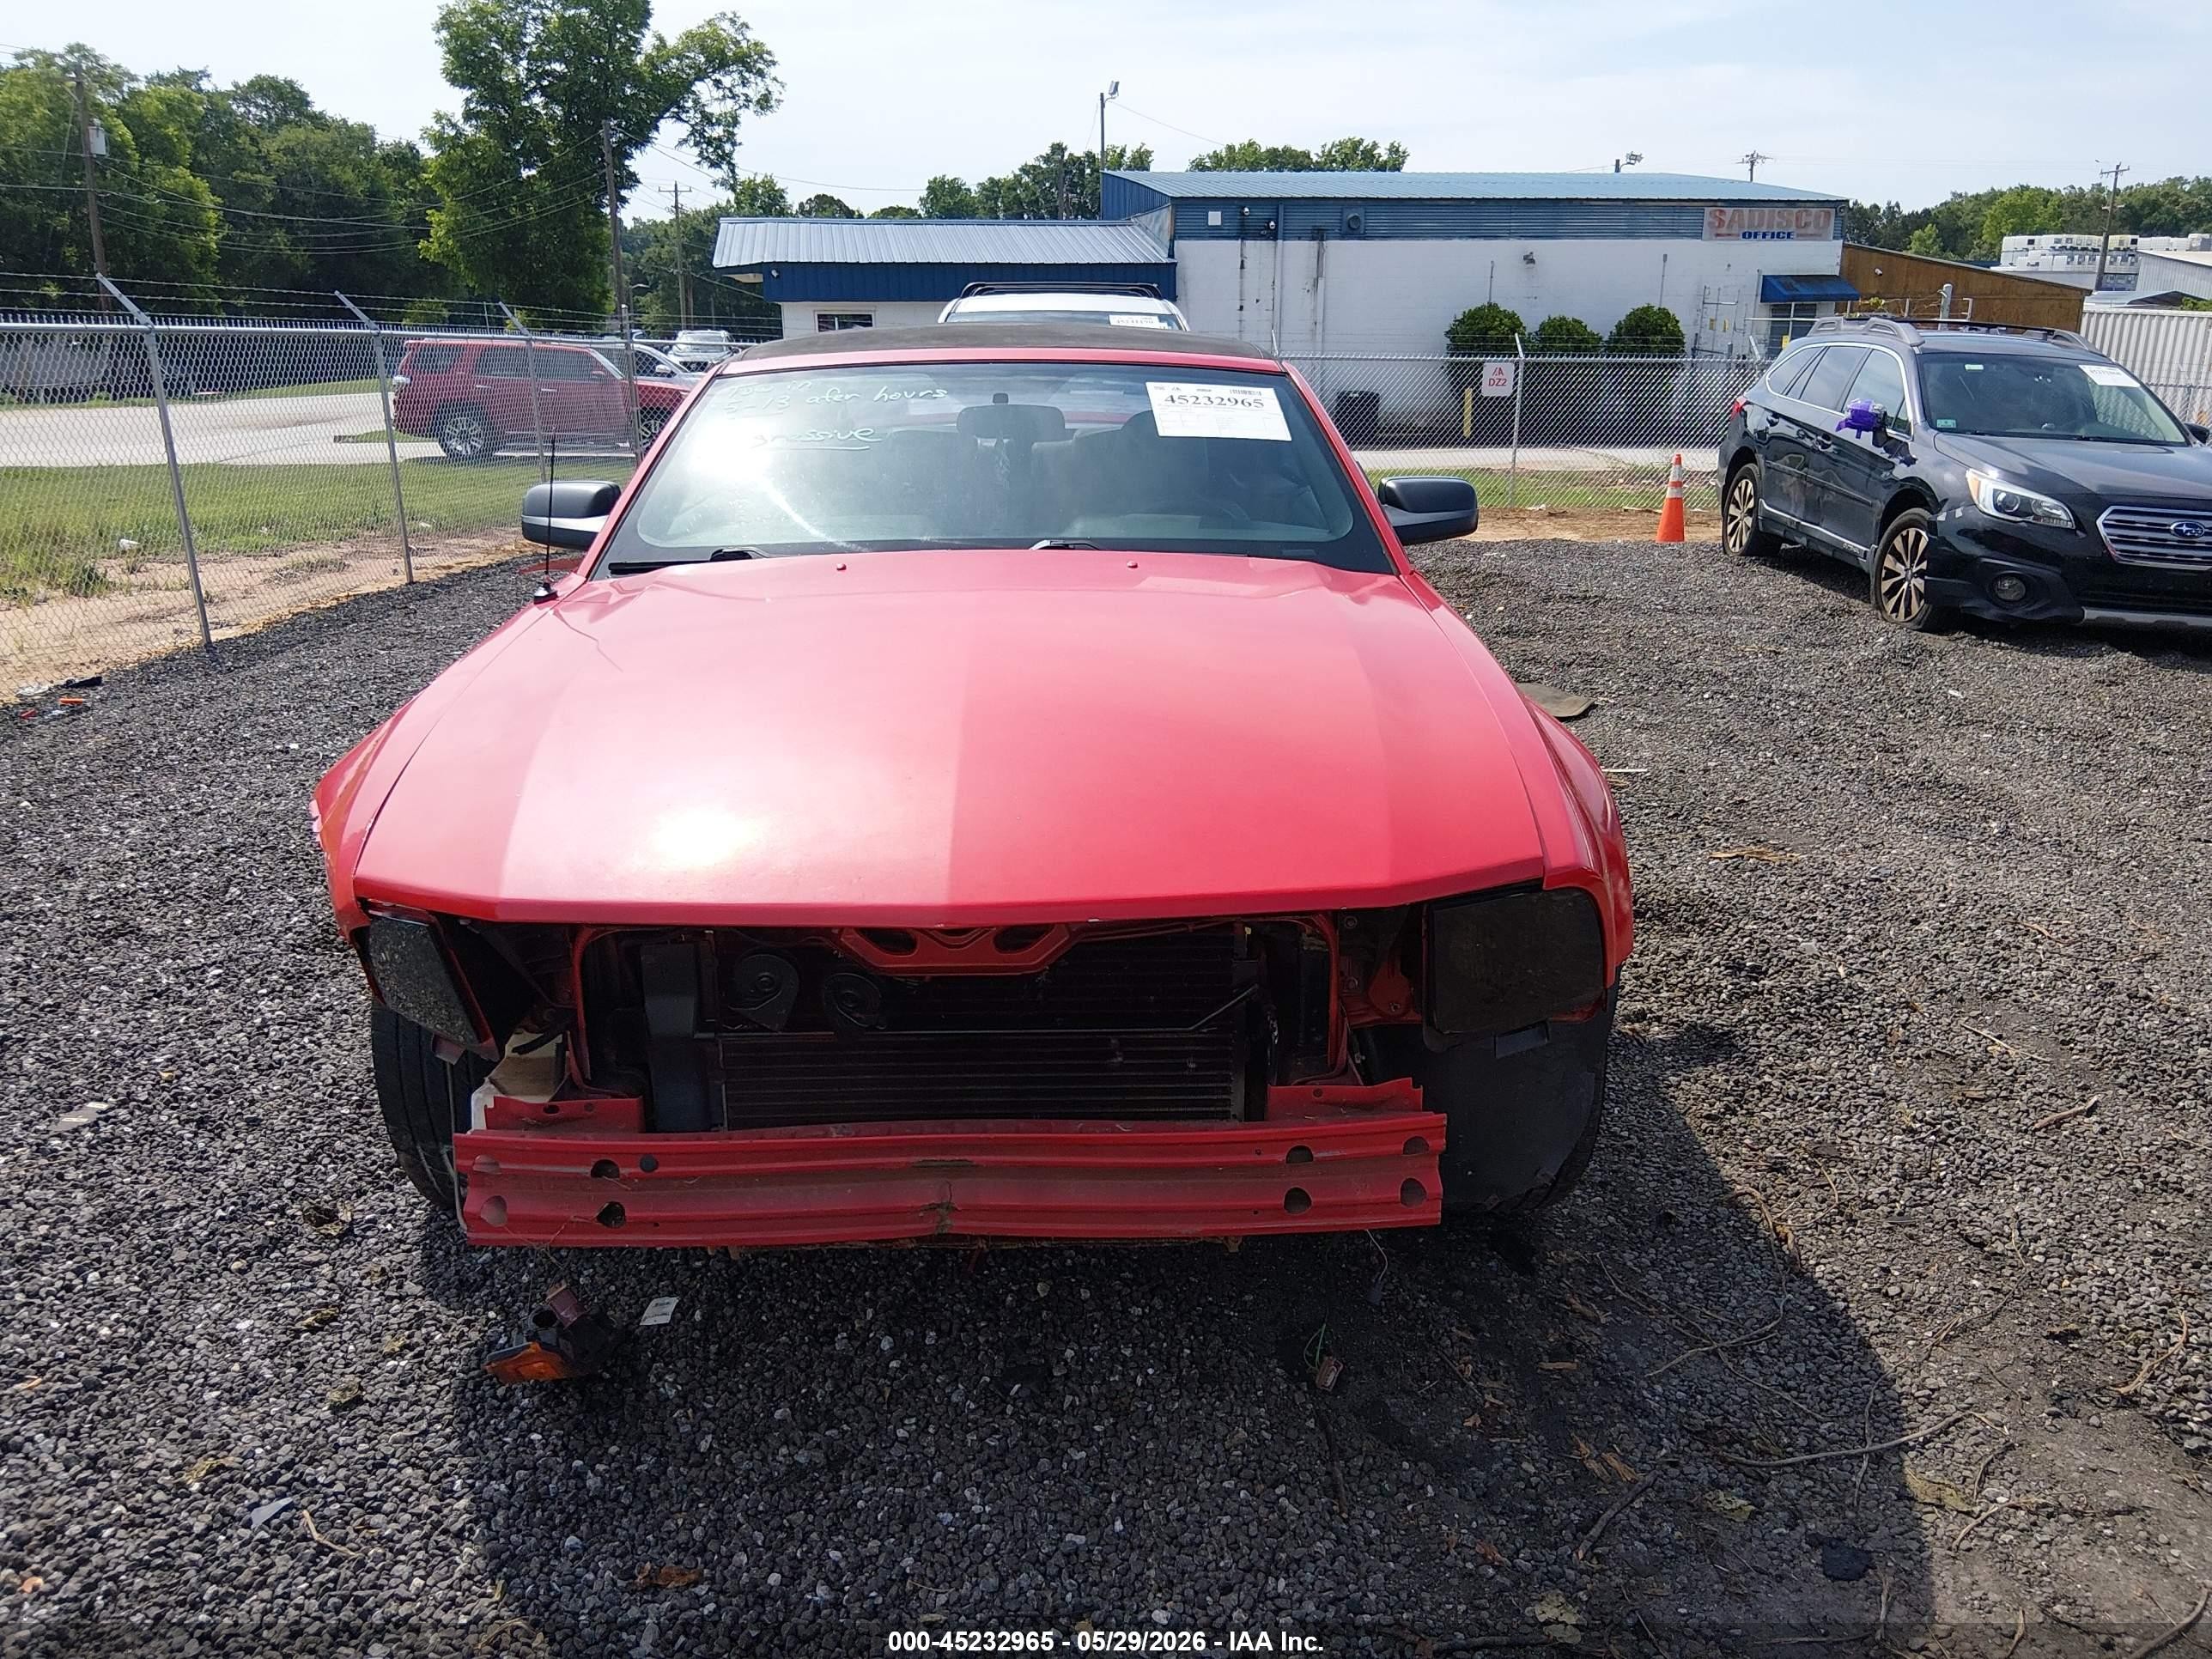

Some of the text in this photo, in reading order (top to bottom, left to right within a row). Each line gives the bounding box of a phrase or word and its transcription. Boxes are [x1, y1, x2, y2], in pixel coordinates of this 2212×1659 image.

[1707, 209, 1832, 229] SADISCO
[1741, 230, 1795, 240] OFFICE
[1488, 378, 1507, 386] DZ2
[872, 385, 949, 404] hours
[1164, 394, 1265, 409] 45232965
